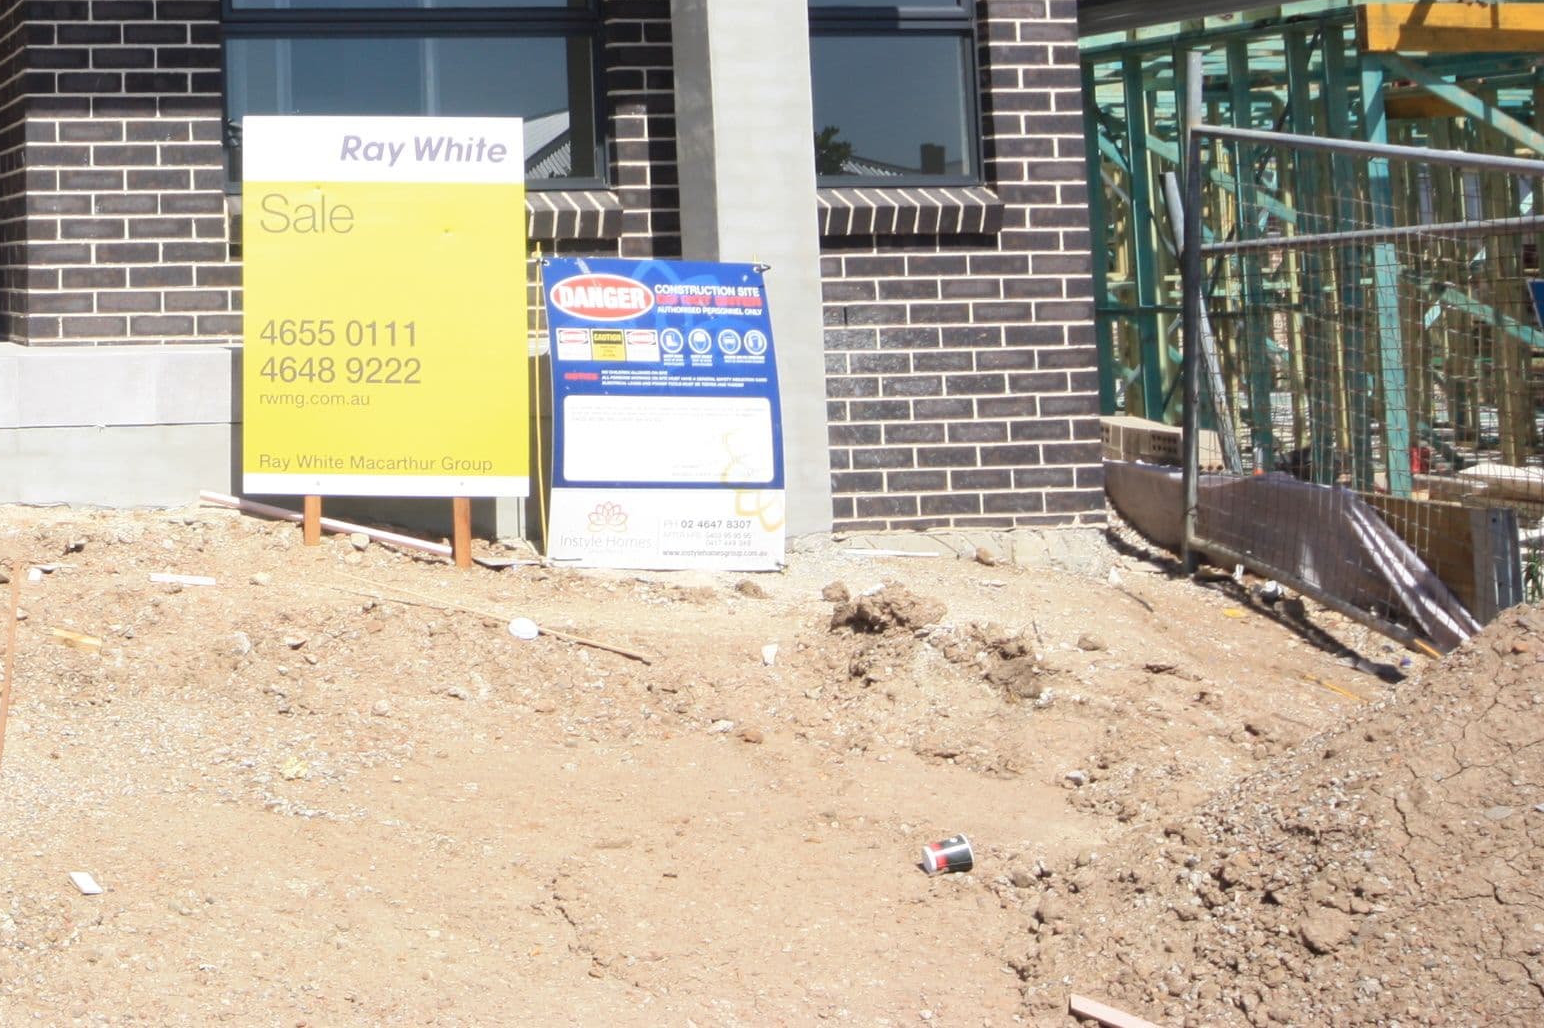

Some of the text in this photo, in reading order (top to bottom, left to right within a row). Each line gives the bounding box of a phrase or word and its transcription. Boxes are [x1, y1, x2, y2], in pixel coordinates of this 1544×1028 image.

[340, 134, 508, 167] Ray White
[259, 192, 355, 234] Sale
[558, 285, 647, 310] DANGER
[654, 284, 760, 297] CONSTRUCTION SITE
[744, 308, 763, 316] ONLY
[259, 319, 418, 348] 4655 0111
[259, 356, 422, 385] 4648 9222
[259, 392, 371, 408] rwmg.com.au
[259, 454, 494, 472] Ray White Macarthur Group
[680, 519, 694, 529] 02
[696, 519, 723, 529] 4647
[725, 519, 752, 529] 8307
[560, 534, 652, 550] Instyle Homes
